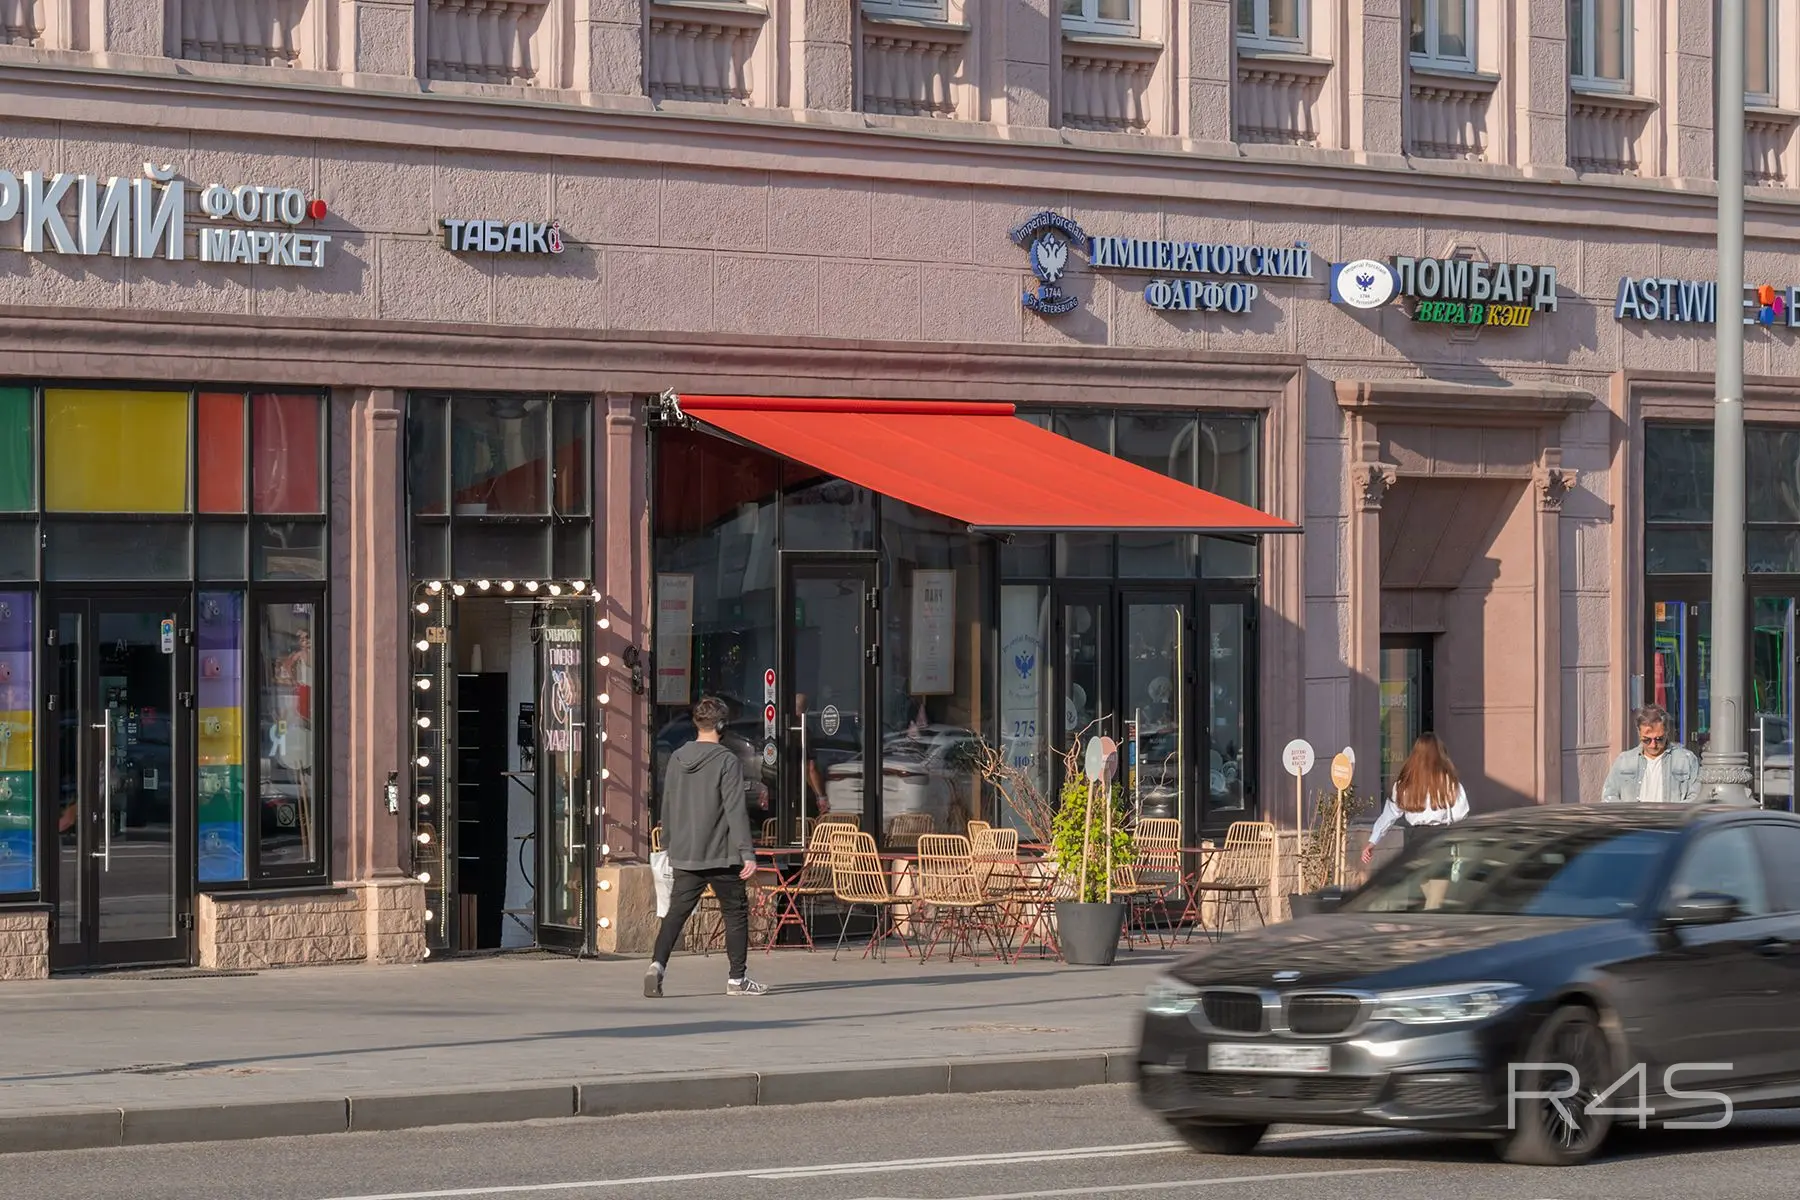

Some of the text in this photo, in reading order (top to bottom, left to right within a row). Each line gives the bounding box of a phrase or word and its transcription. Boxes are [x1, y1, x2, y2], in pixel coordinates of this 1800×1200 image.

[200, 184, 306, 225] ФОТО
[445, 219, 548, 253] ТАБАК
[1016, 212, 1086, 244] Imperial Porcelain
[200, 228, 331, 267] МАРКЕТ
[1091, 236, 1313, 278] ИМПЕРАТОРСКИЙ
[1045, 287, 1062, 298] 1744
[1149, 279, 1258, 313] ФАРФОР
[1617, 276, 1755, 325] AST.WIE
[1419, 301, 1533, 327] ВЕРА В КЭШ
[1014, 720, 1036, 738] 275
